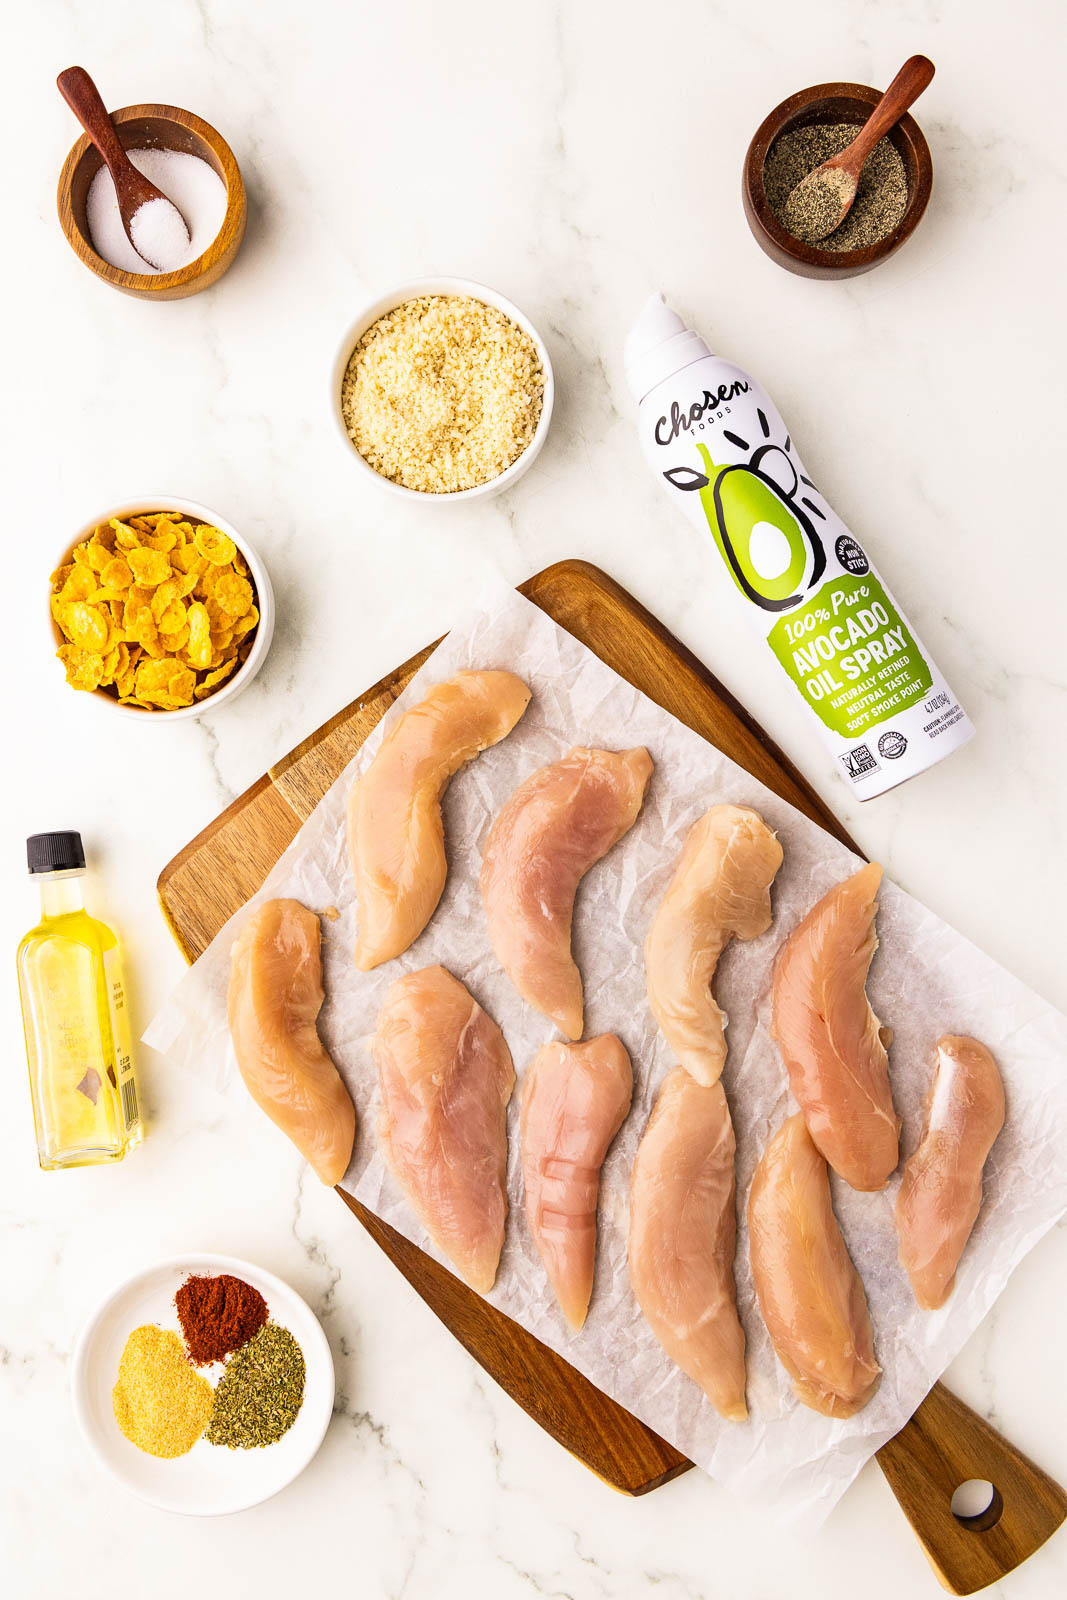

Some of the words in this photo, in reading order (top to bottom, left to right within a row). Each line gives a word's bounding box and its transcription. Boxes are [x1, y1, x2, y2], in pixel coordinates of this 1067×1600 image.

[655, 381, 749, 446] Chosen
[690, 406, 732, 436] FOODS
[846, 549, 860, 559] NON
[847, 558, 867, 570] STICK
[784, 608, 830, 645] 100%
[830, 585, 870, 616] Pure
[792, 601, 889, 677] AVOCADO
[806, 669, 844, 701] OIL
[839, 625, 908, 680] SPRAY
[830, 675, 878, 710] NATURALLY
[877, 655, 910, 681] REFINED
[846, 687, 886, 716] NEUTRAL
[885, 671, 911, 692] TASTE
[846, 712, 870, 732] 500°F
[872, 694, 901, 718] SMOKE
[901, 679, 923, 699] POINT
[850, 761, 876, 777] VERIFIED
[852, 746, 867, 756] NON
[855, 751, 870, 762] GMO
